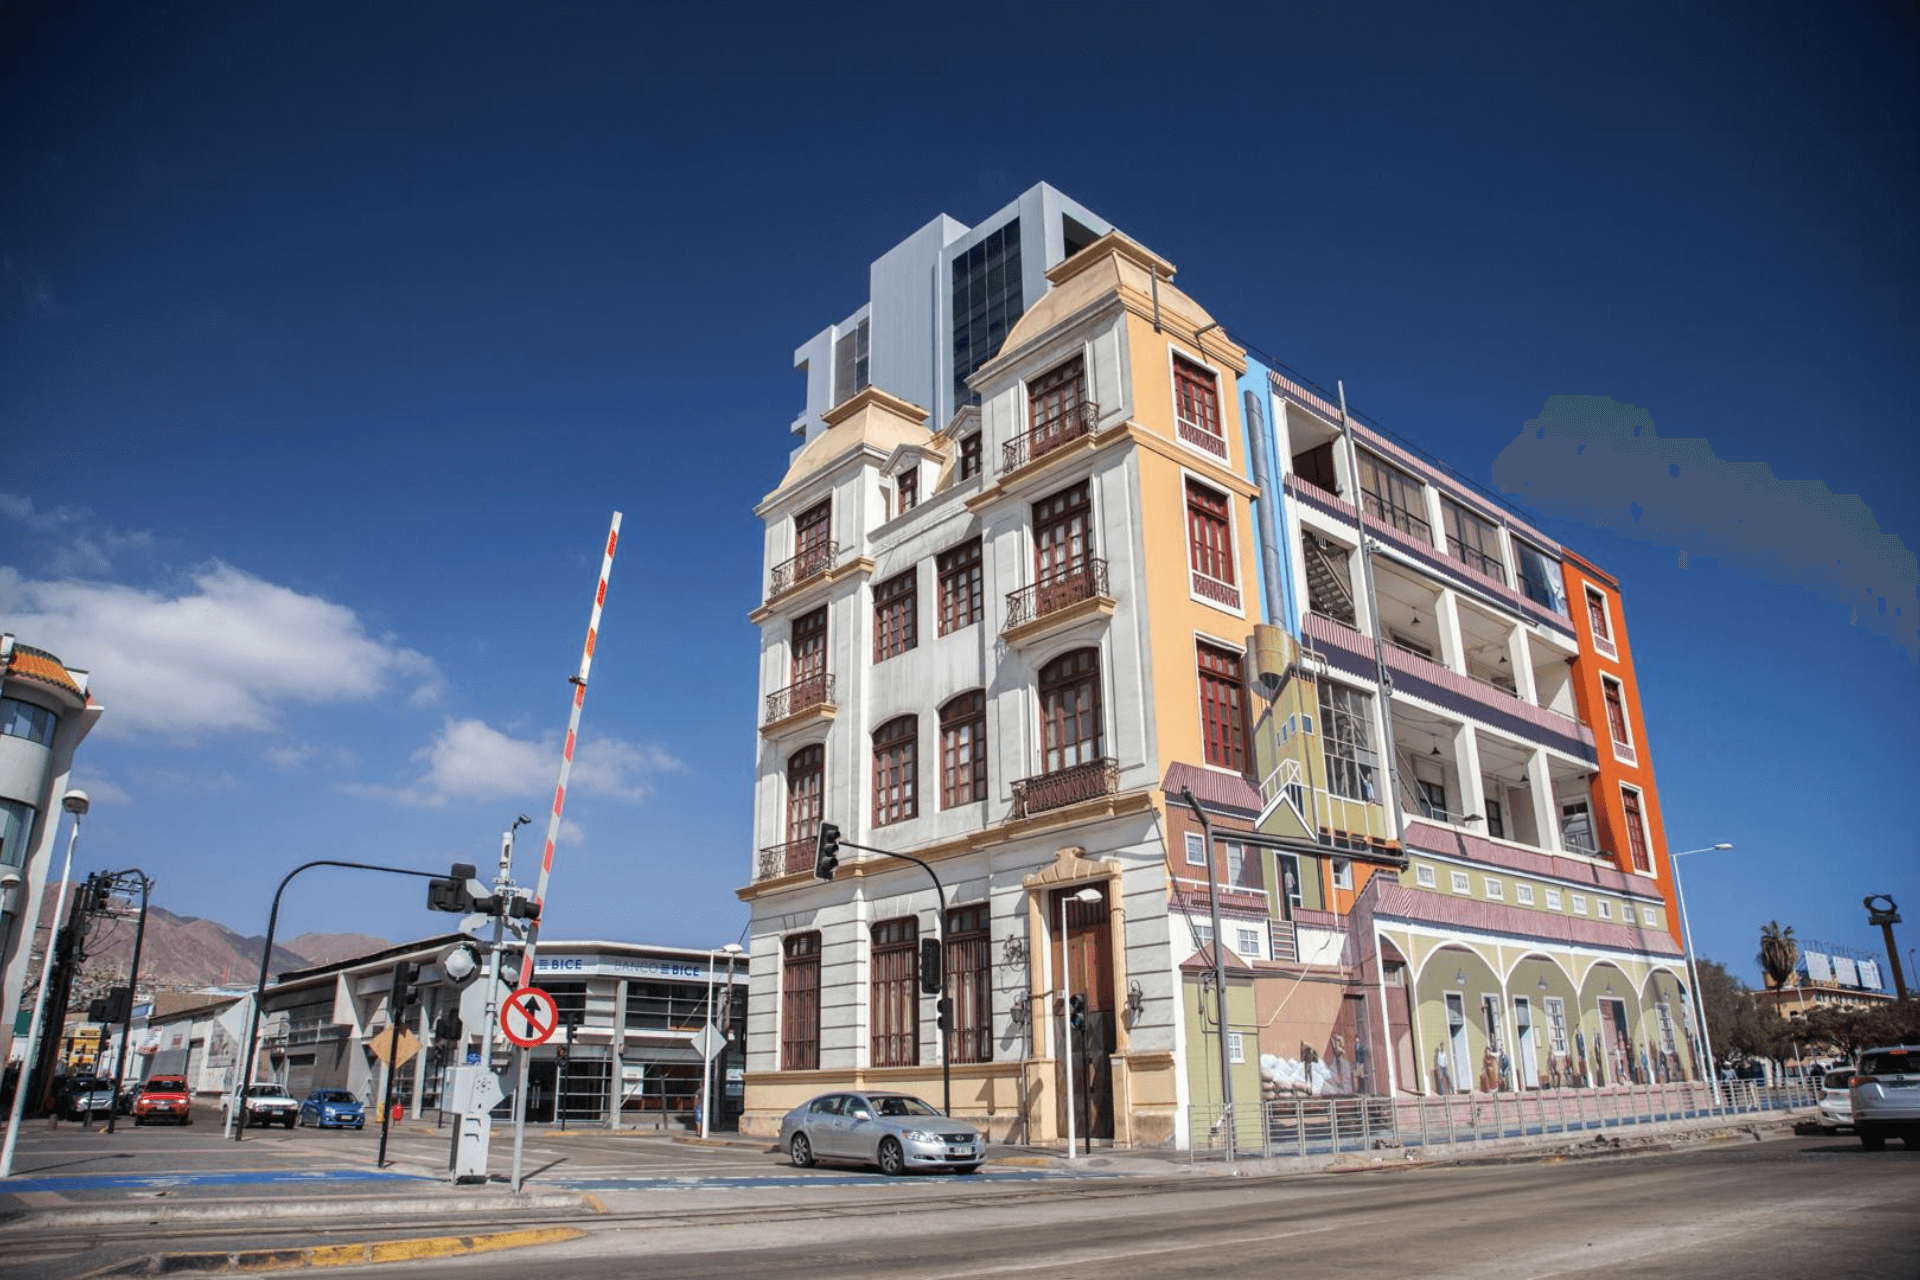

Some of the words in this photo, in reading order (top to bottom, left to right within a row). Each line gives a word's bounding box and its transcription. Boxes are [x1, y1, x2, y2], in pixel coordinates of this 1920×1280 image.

[551, 959, 582, 970] BICE
[614, 960, 658, 974] BANCO
[672, 964, 700, 977] BICE
